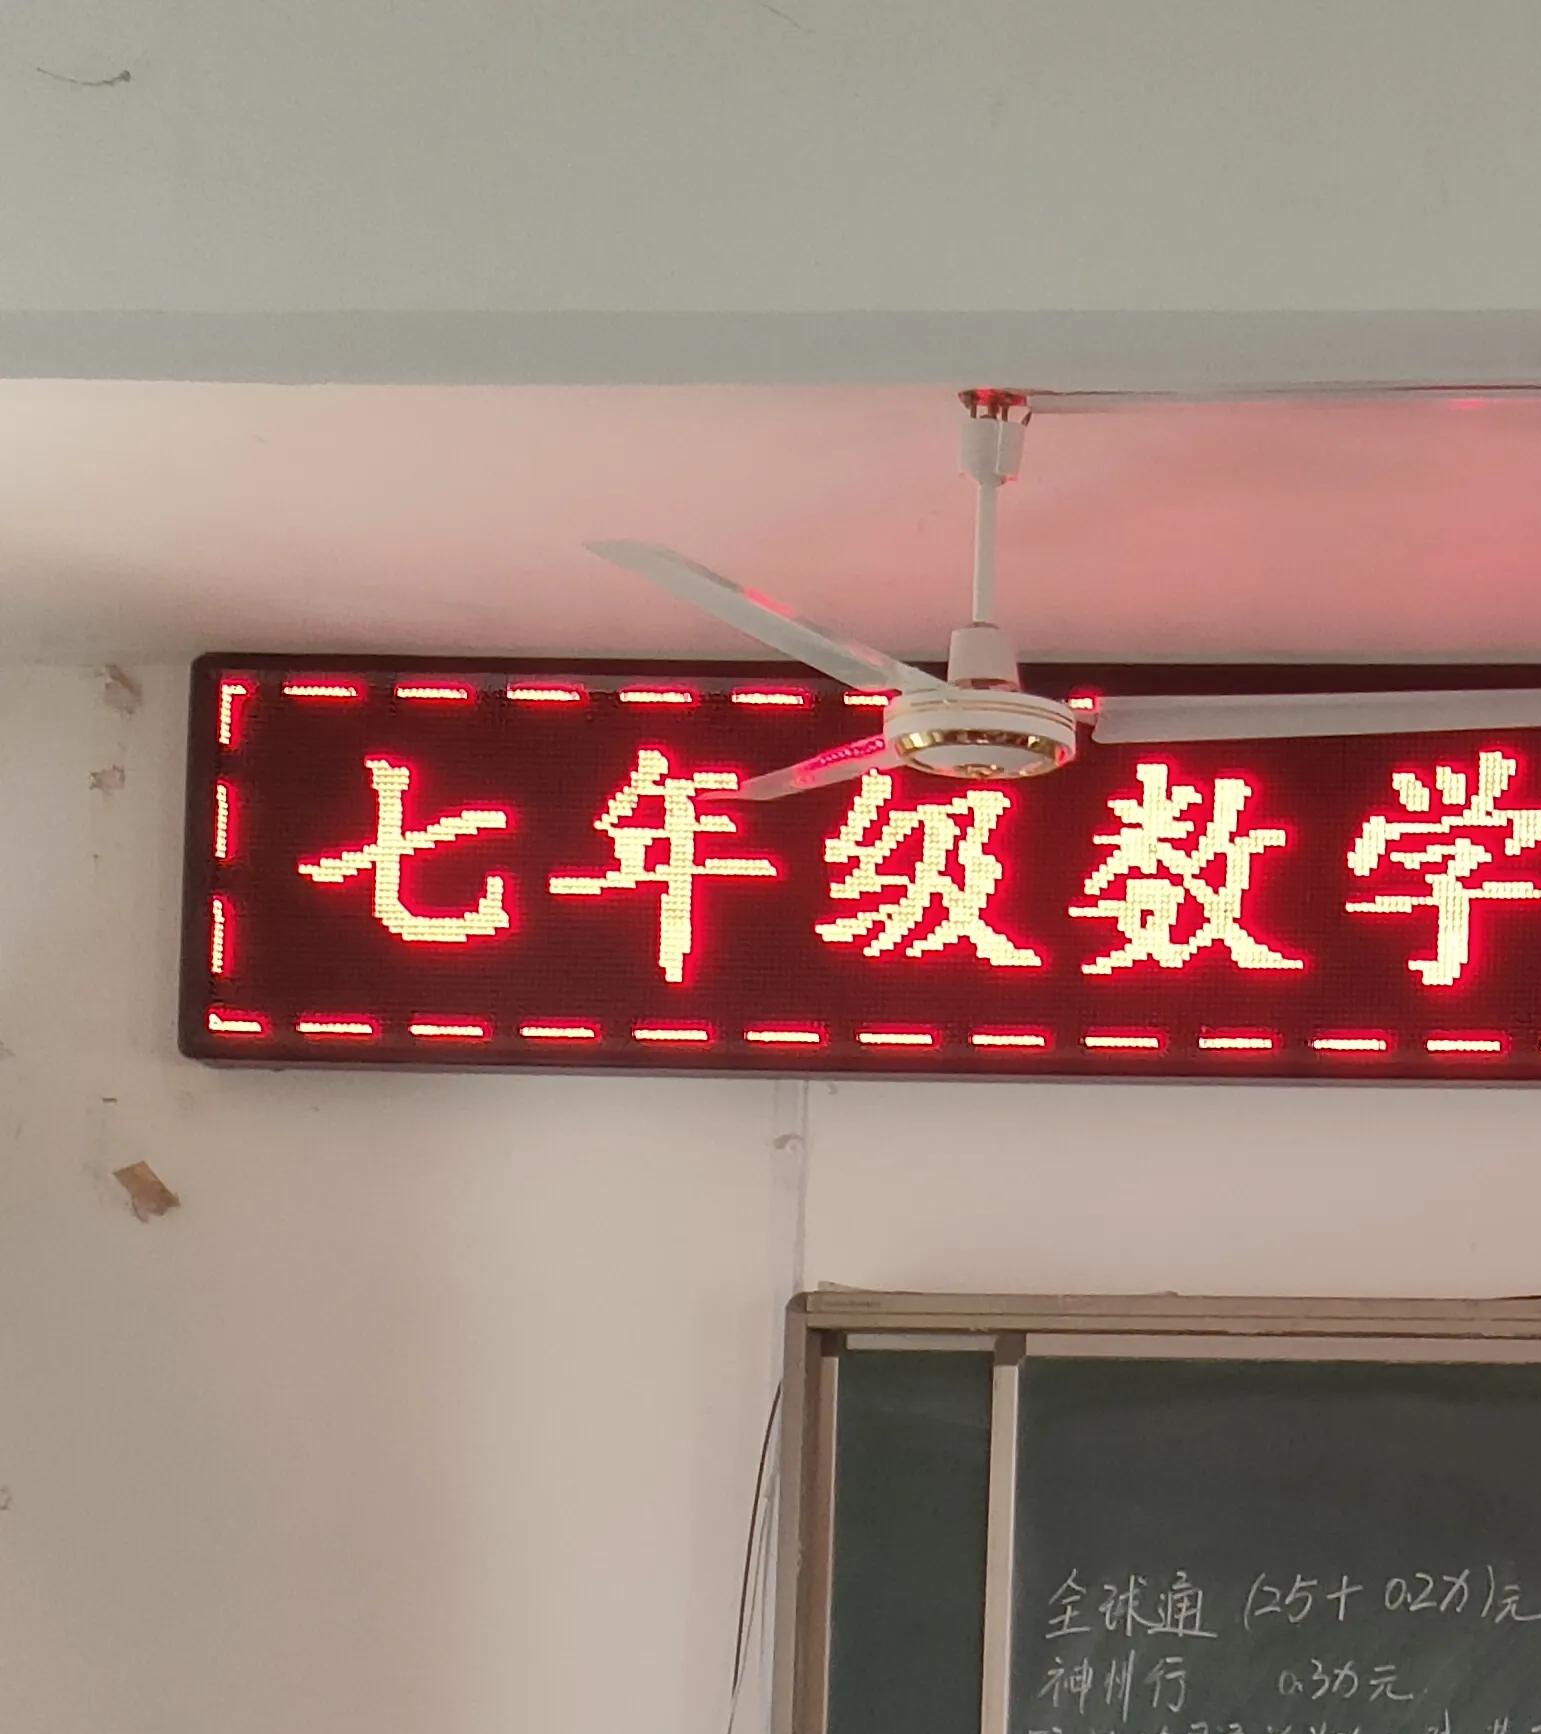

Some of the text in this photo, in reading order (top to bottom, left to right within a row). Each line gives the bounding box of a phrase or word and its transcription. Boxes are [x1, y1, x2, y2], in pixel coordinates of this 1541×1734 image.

[1045, 1567, 1218, 1638] 全球通
[1037, 1649, 1188, 1723] 神州行
